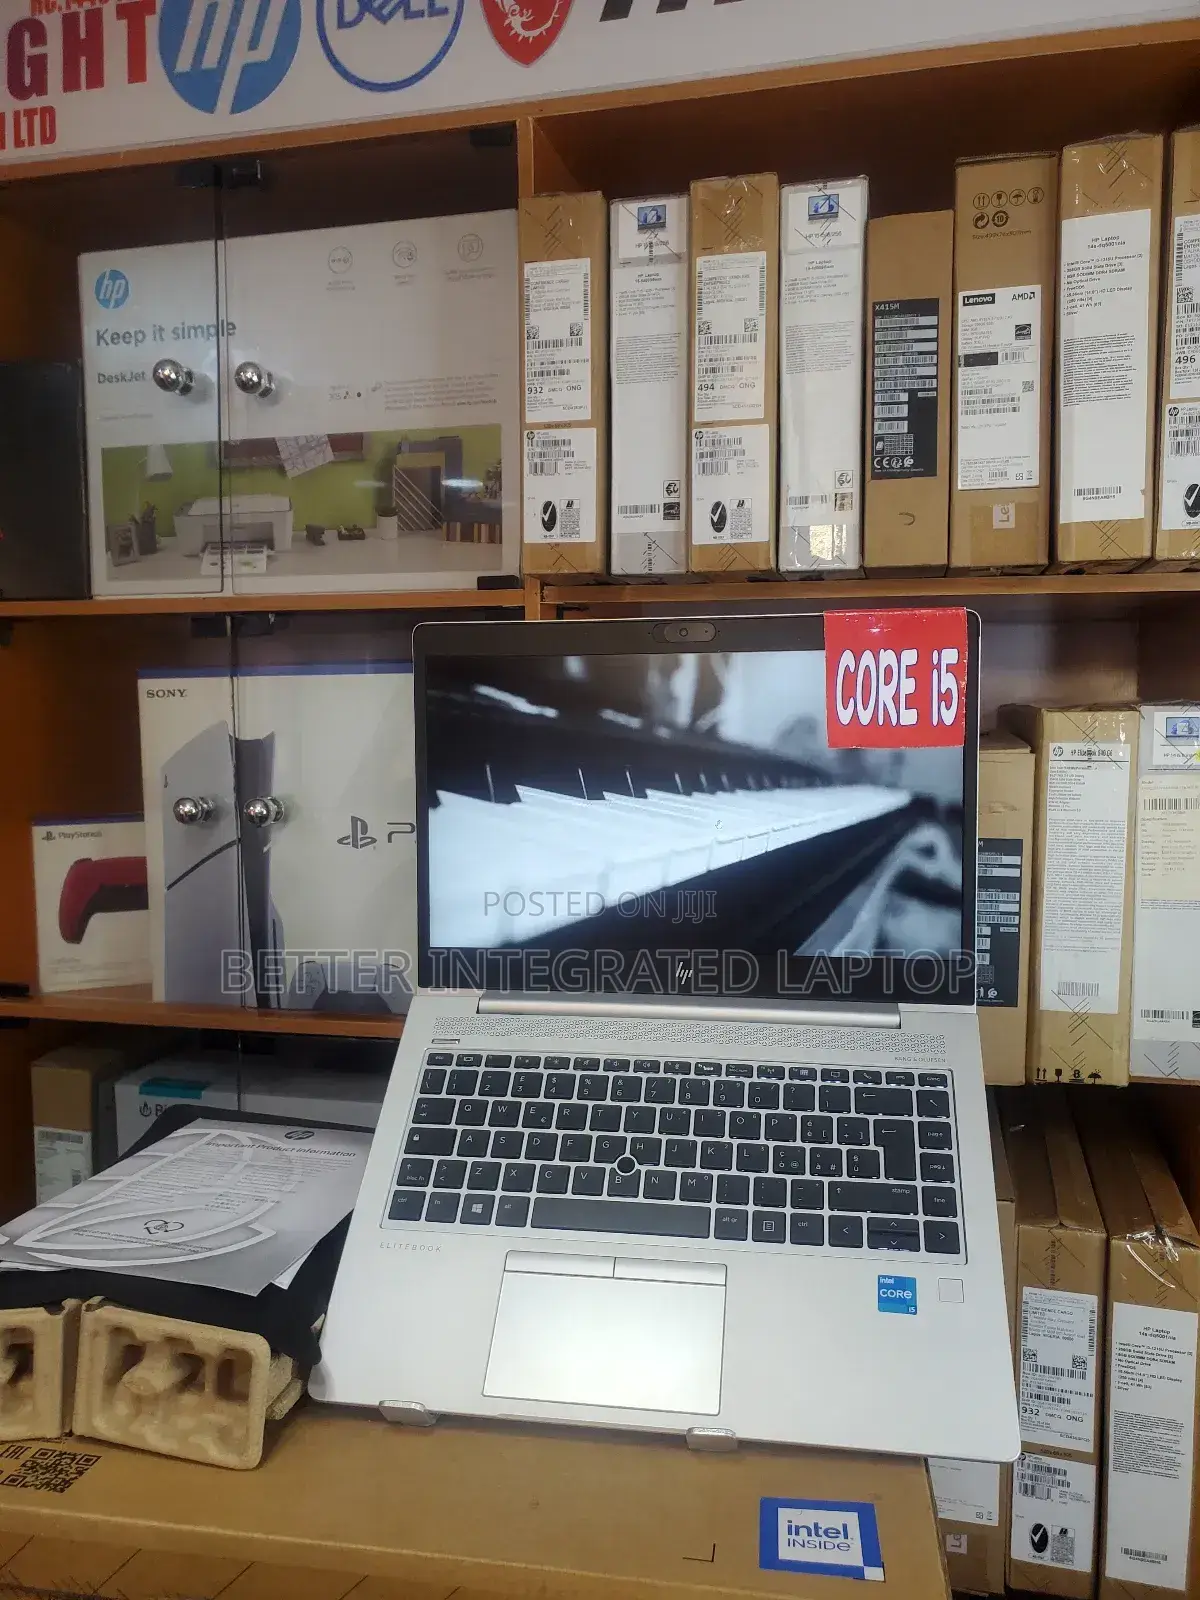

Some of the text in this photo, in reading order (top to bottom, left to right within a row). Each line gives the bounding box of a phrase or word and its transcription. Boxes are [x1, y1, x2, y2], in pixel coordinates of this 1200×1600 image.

[13, 105, 57, 149] LTD
[964, 296, 993, 304] Lenovo
[1012, 293, 1029, 301] AMD
[874, 303, 900, 311] X415M
[96, 319, 237, 347] Keep it simple
[1175, 355, 1196, 364] 496
[97, 371, 146, 384] DeskJet
[527, 386, 544, 395] 932
[566, 384, 582, 392] ONG
[698, 383, 715, 392] 494
[835, 648, 959, 727] CORE i5
[146, 689, 188, 698] SONY
[685, 1092, 691, 1100] 8
[464, 1104, 472, 1113] Q
[498, 1105, 508, 1113] W
[530, 1106, 536, 1114] E
[563, 1108, 570, 1116] R
[597, 1109, 604, 1117] T
[632, 1111, 639, 1119] Y
[666, 1112, 673, 1121] U
[771, 1118, 778, 1126] P
[205, 1141, 357, 1157] Important Product Information
[465, 1135, 750, 1157] A S D F G H J K L
[475, 1167, 910, 1195] Z X C V B N M stamp
[379, 1241, 442, 1252] ELITEBOOK
[1152, 1327, 1170, 1335] Laptop
[1021, 1406, 1040, 1417] 932
[1066, 1414, 1084, 1423] ONG
